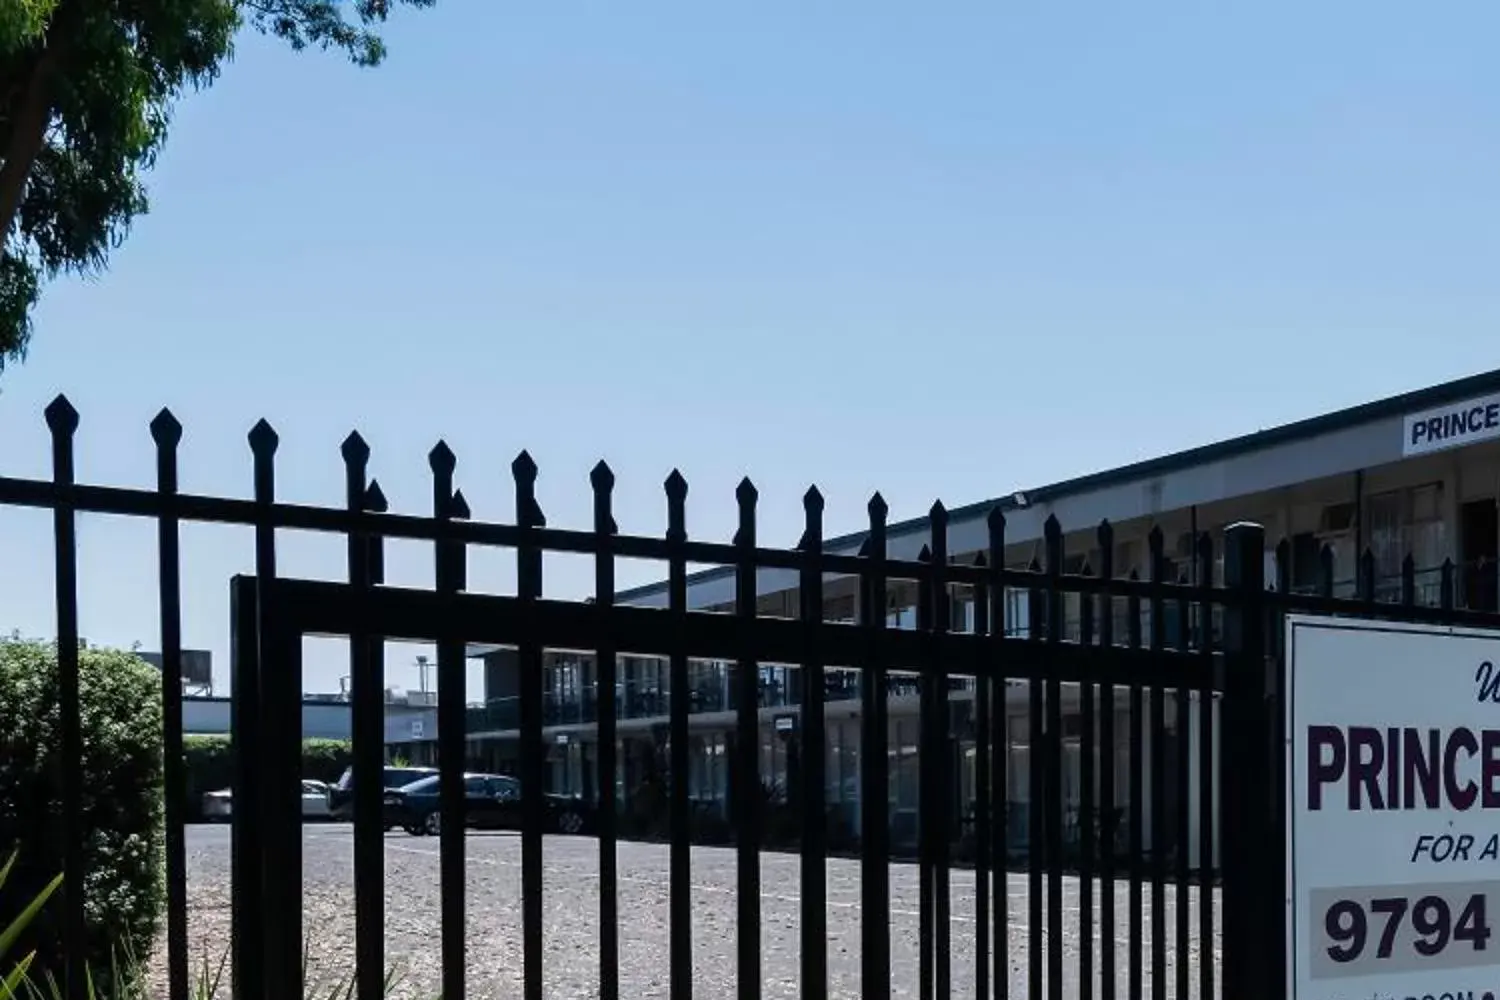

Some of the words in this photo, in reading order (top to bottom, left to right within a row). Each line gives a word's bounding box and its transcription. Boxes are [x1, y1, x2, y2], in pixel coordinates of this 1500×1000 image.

[1411, 403, 1500, 445] PRINCE
[1411, 834, 1474, 862] FOR
[1480, 833, 1498, 861] A
[1325, 894, 1491, 963] 9794
